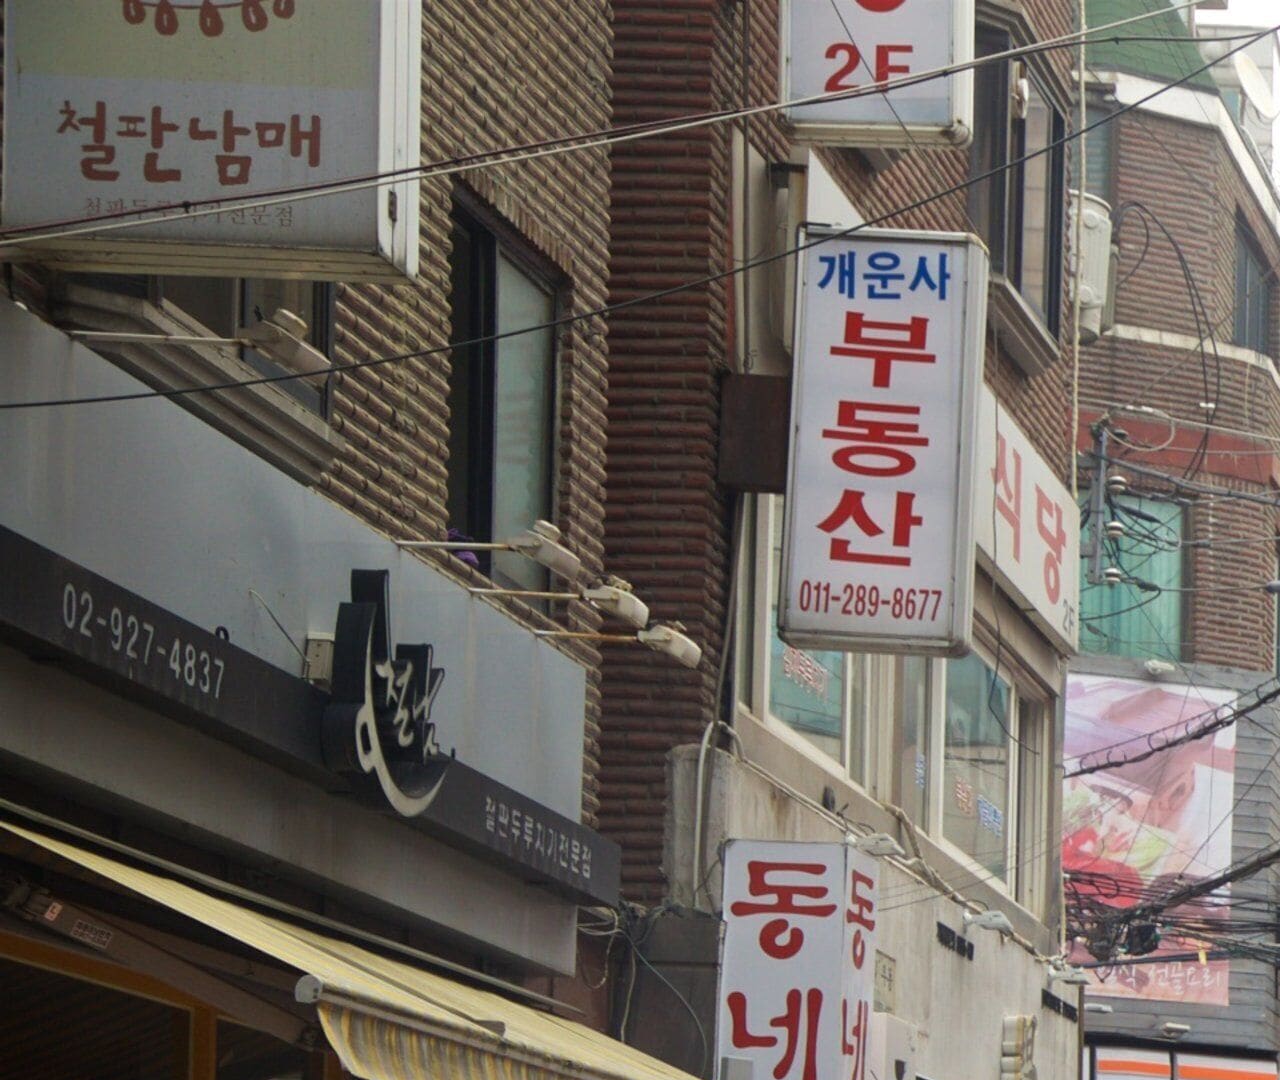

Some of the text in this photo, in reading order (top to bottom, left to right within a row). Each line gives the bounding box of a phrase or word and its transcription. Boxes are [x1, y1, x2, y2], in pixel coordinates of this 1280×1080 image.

[824, 42, 914, 94] 2F
[57, 101, 321, 186] 철판남매
[818, 250, 951, 301] 개운사
[816, 311, 937, 568] 부동산
[990, 430, 1067, 605] 식당
[62, 582, 225, 699] 02-927-4837
[799, 580, 943, 623] 011-289-8677
